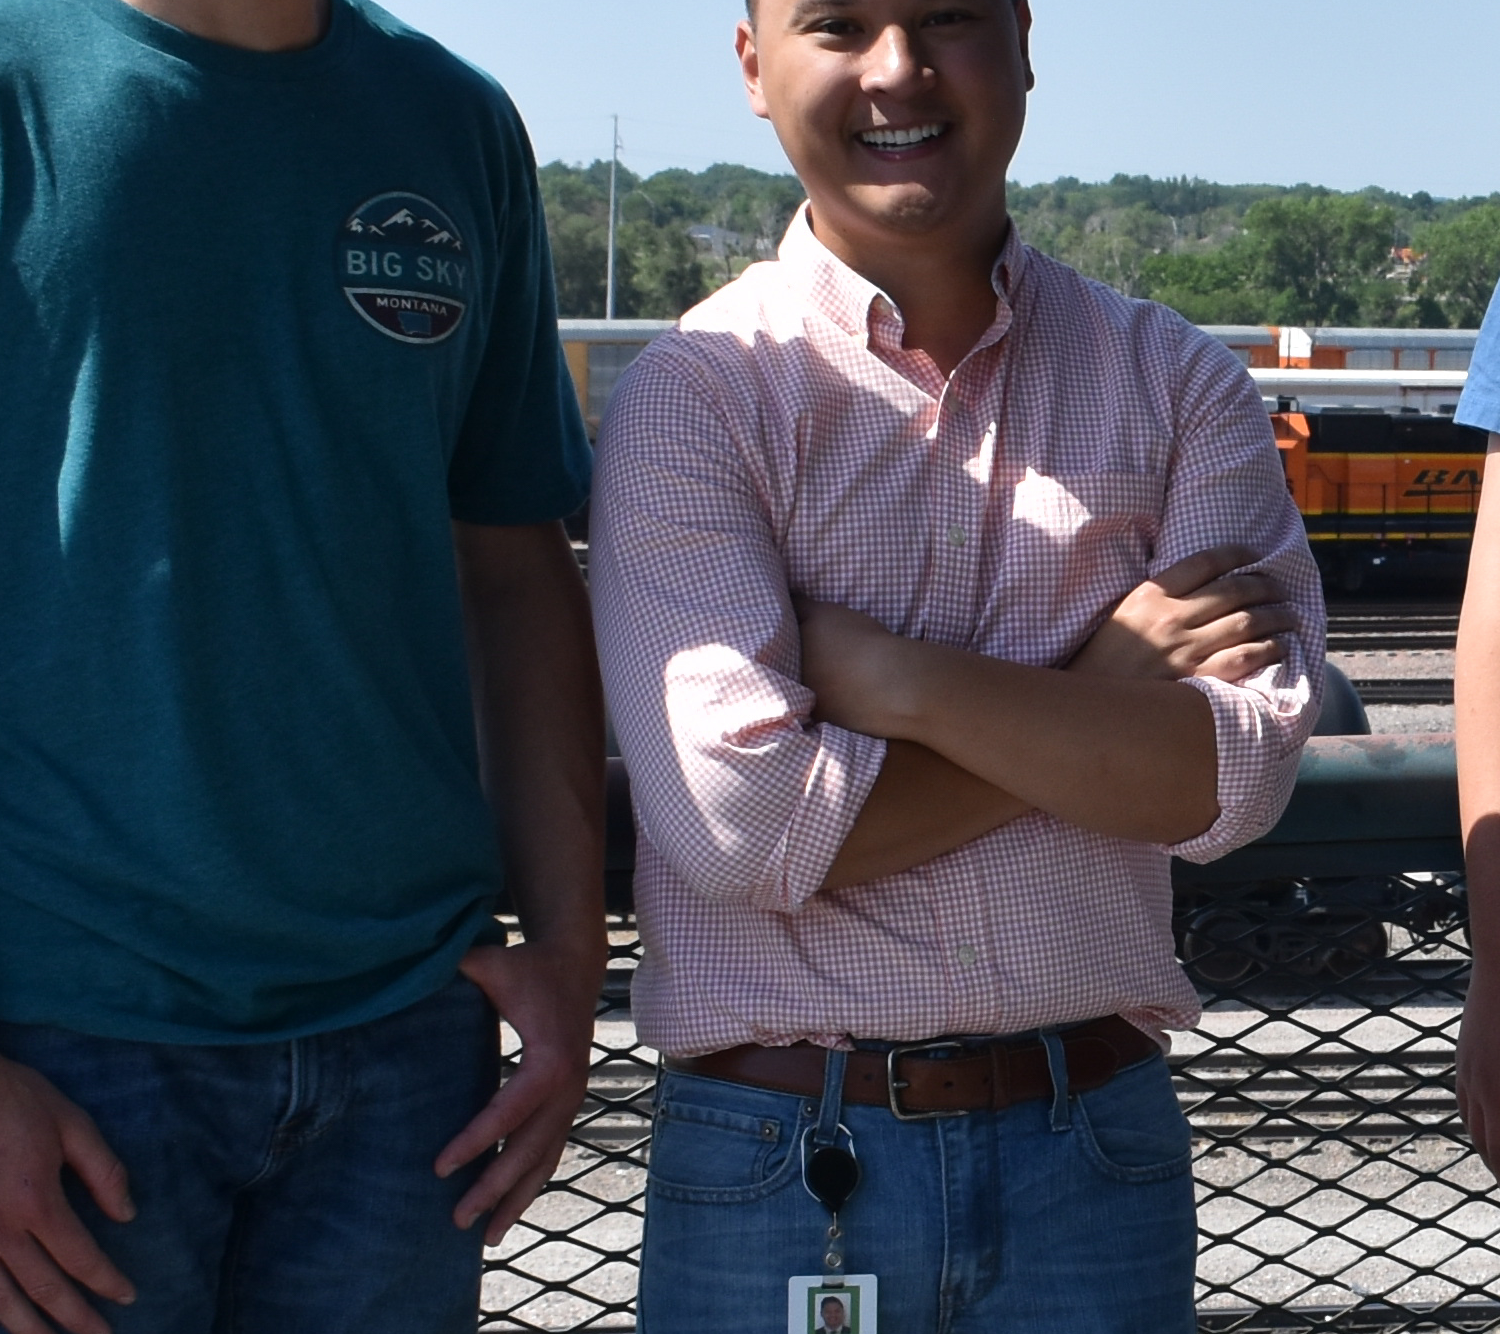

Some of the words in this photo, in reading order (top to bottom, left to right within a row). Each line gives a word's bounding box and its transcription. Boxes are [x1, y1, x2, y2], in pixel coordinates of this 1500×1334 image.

[346, 249, 403, 278] BIG
[416, 255, 466, 289] SKY
[376, 296, 448, 316] MONTANA
